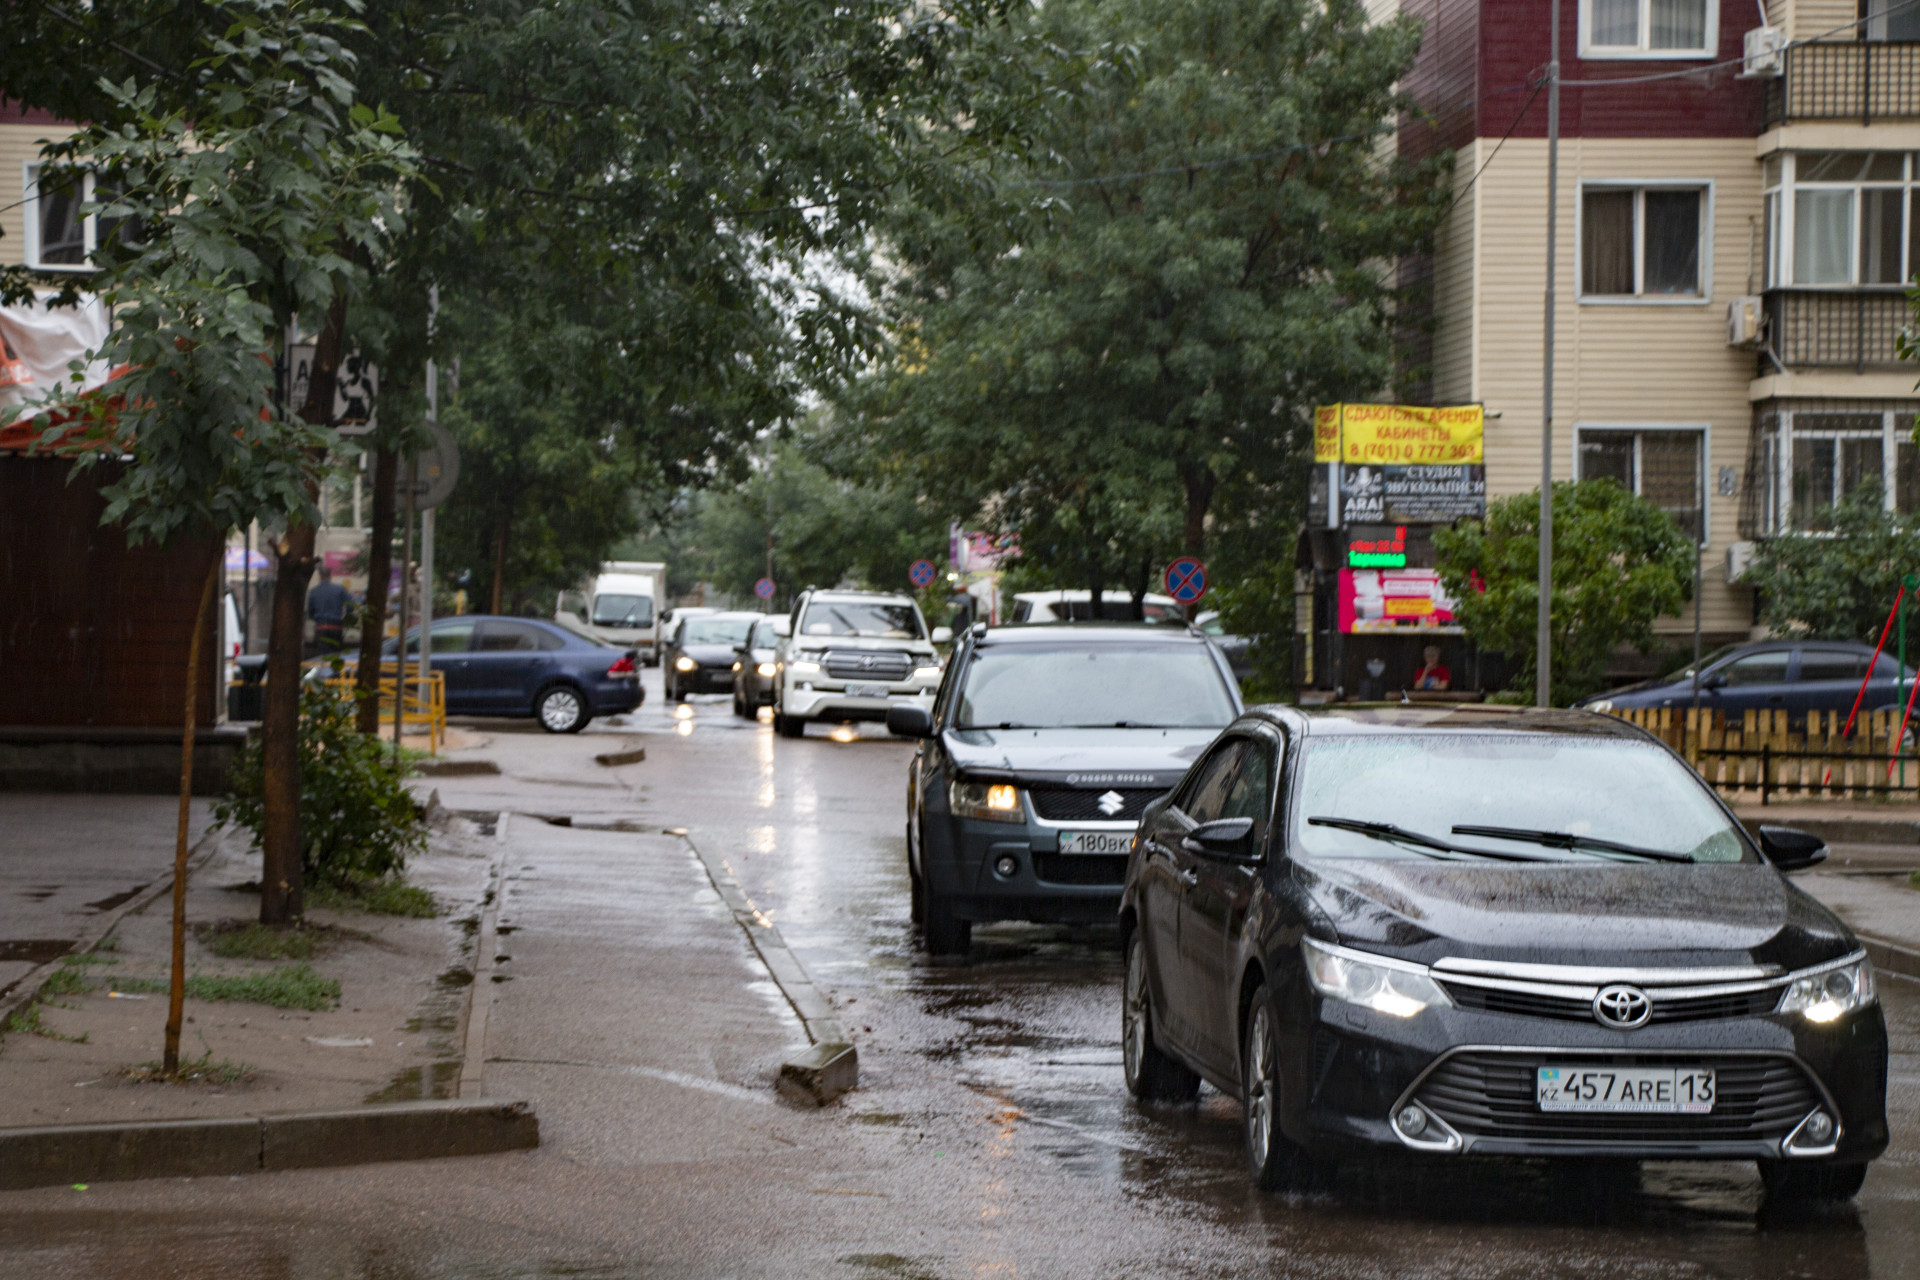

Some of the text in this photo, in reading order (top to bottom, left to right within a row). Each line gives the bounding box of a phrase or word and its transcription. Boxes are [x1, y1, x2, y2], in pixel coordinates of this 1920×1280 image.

[1345, 406, 1412, 422] СДАЮТСЯ
[1428, 408, 1480, 424] АРЕНДУ
[1376, 426, 1450, 441] КАБИНЕТЫ
[1350, 443, 1359, 457] 8
[1364, 443, 1400, 460] (701)
[1404, 444, 1413, 458] 0
[1419, 444, 1445, 458] 777
[1450, 444, 1476, 458] 303
[1407, 466, 1462, 478] СТУДИЯ
[1386, 480, 1485, 494] ЗВУКОЗАПИСИ
[1344, 497, 1384, 512] ARAI
[1343, 511, 1384, 523] STUDIO
[1540, 1088, 1558, 1100] KZ
[1680, 1074, 1713, 1102] 13
